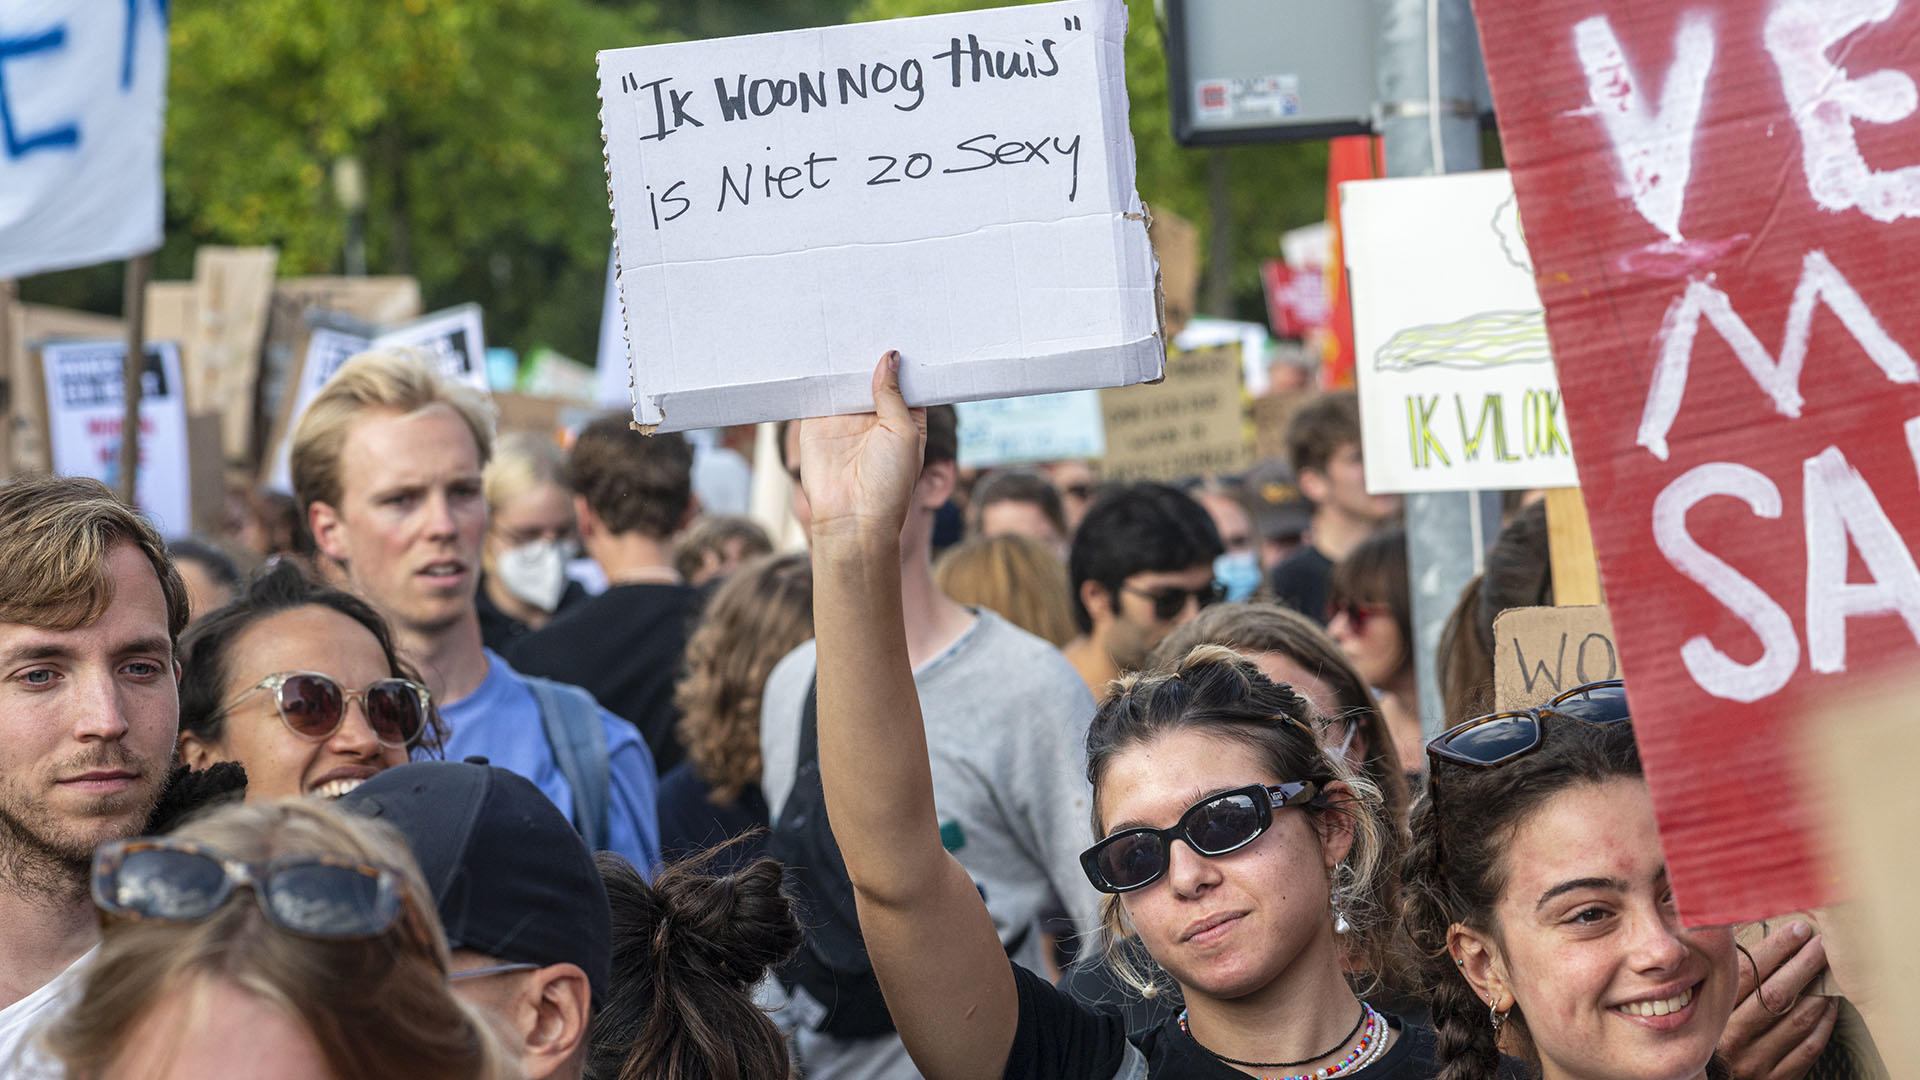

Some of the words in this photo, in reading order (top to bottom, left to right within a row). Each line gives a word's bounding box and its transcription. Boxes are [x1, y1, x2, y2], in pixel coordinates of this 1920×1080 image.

[714, 71, 827, 122] WOON
[646, 180, 691, 230] is
[943, 133, 1081, 202] Sexy
[1405, 394, 1451, 469] IK
[1652, 416, 1920, 703] SA
